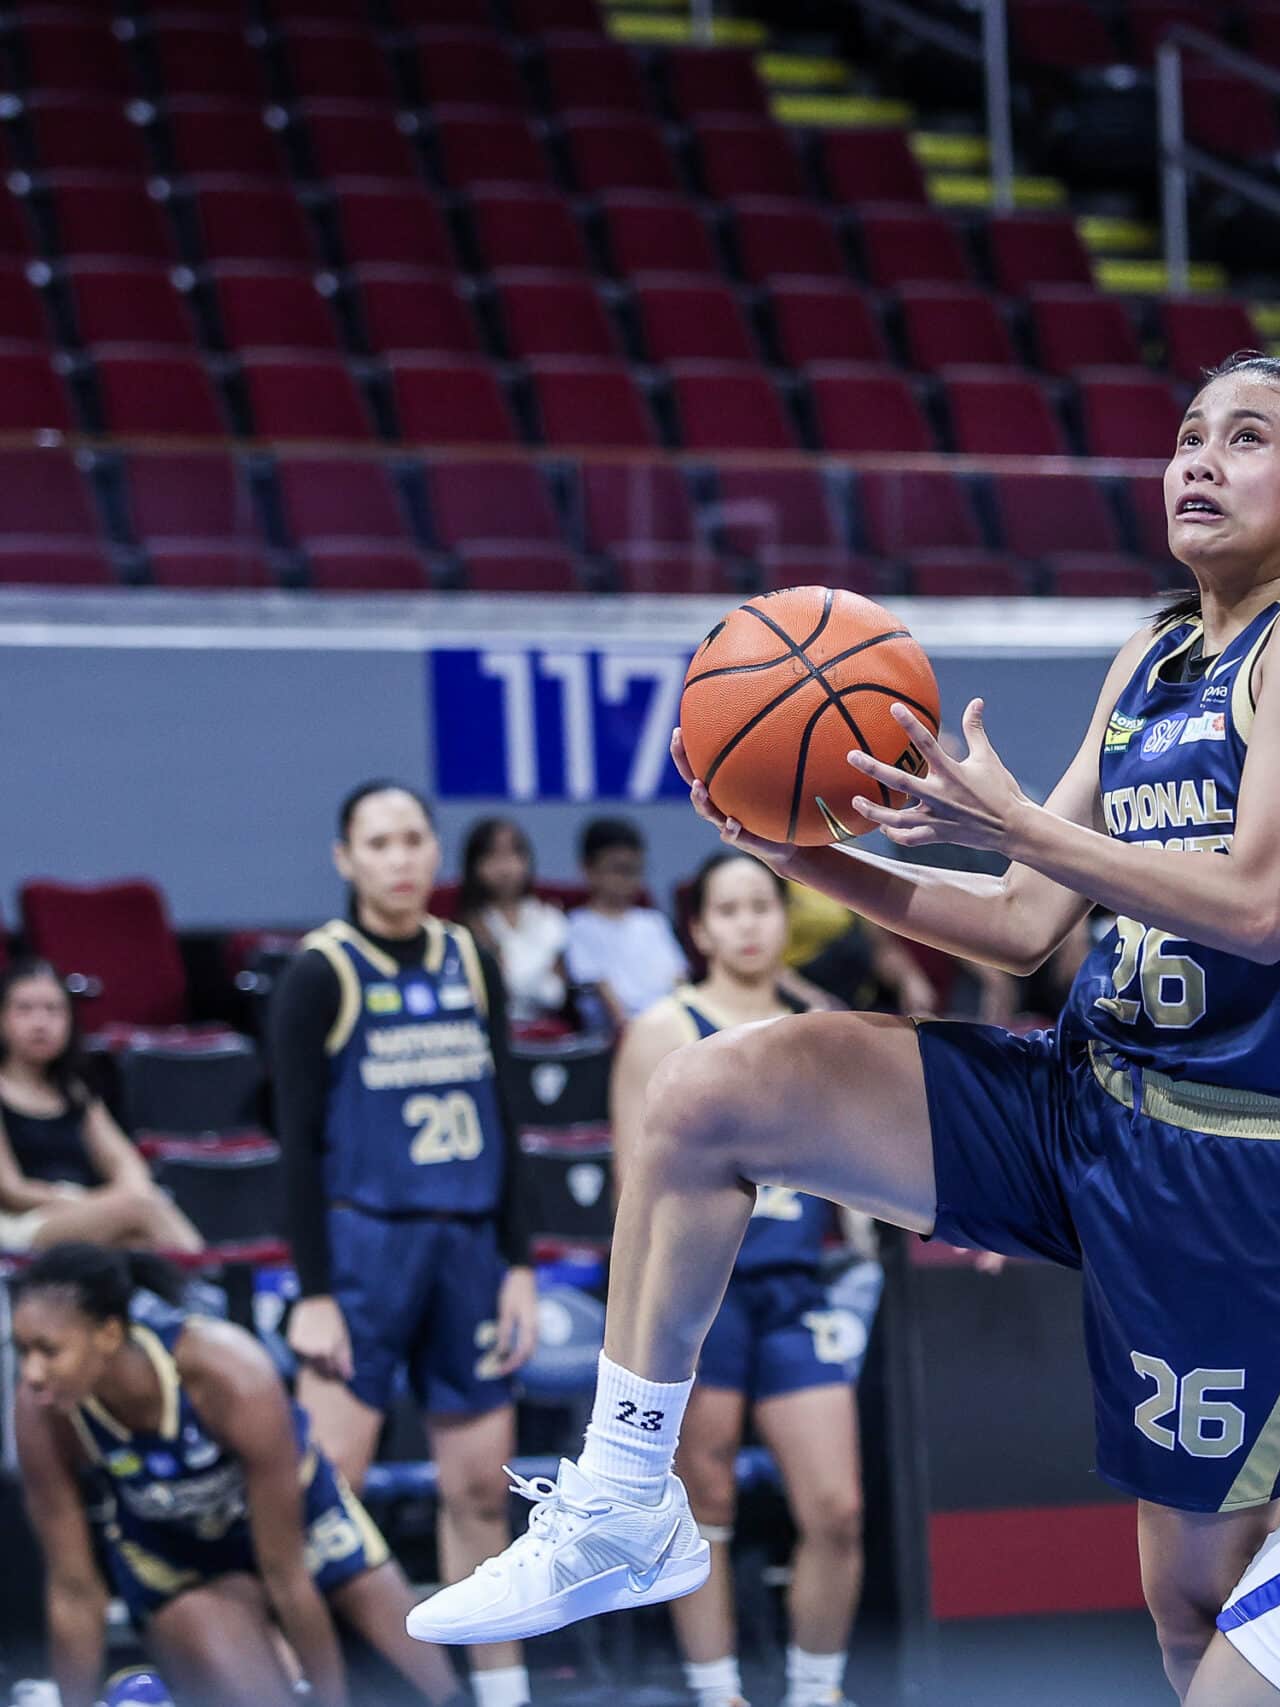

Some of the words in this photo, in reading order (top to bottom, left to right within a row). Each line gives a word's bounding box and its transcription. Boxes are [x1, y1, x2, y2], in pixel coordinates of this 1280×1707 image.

[480, 652, 686, 801] 117
[1094, 915, 1206, 1029] 26
[402, 1091, 484, 1165] 20
[615, 1400, 665, 1432] 23
[1130, 1350, 1246, 1458] 26
